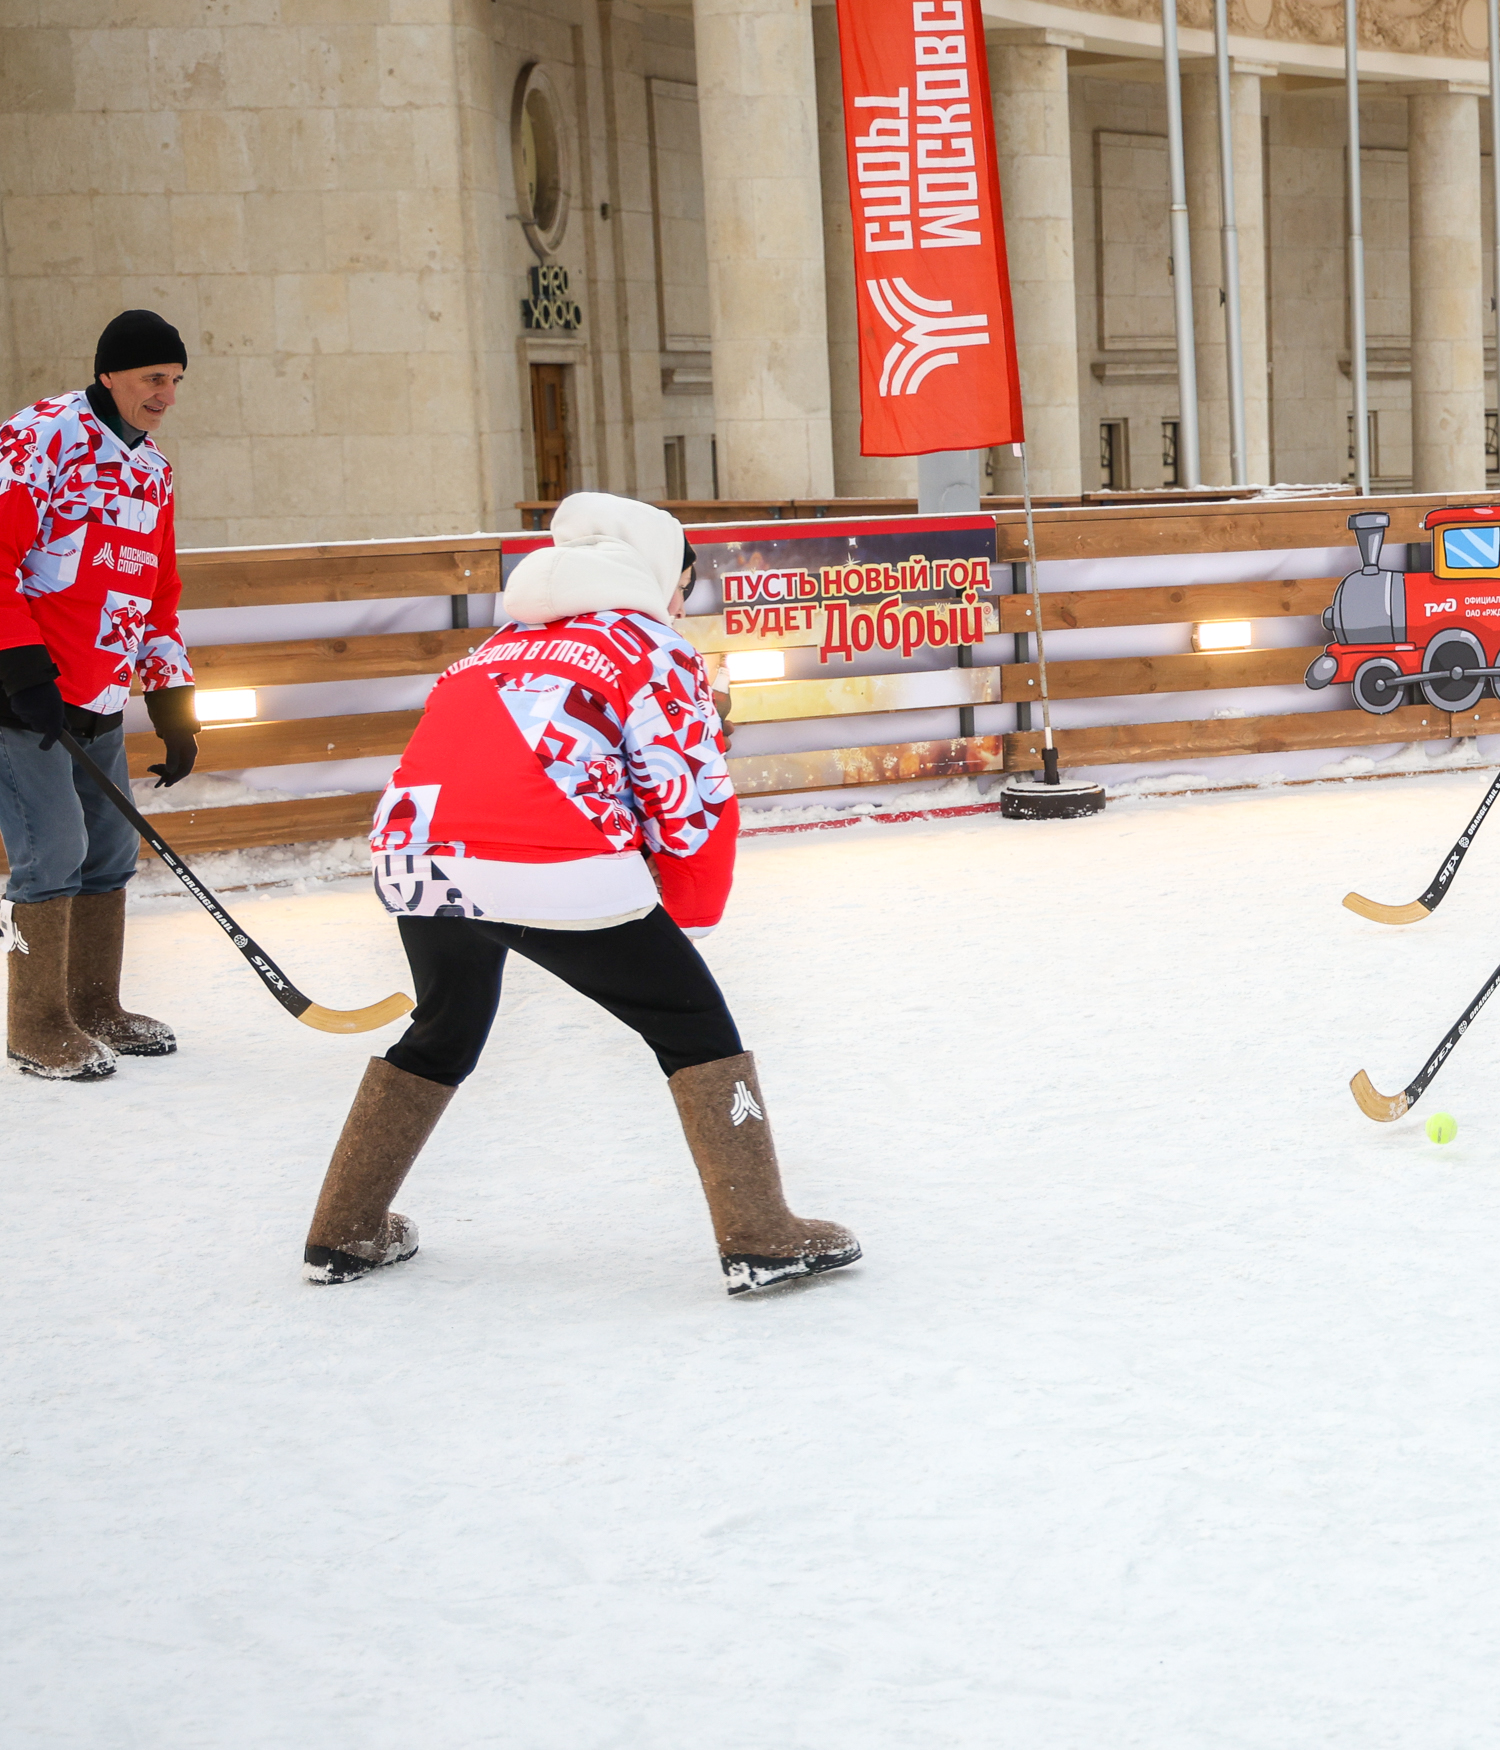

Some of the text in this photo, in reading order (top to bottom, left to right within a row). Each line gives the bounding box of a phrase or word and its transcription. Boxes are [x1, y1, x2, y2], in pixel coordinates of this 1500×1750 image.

[854, 87, 913, 252] СПОРТ
[117, 559, 144, 577] СПОРТ
[724, 558, 991, 601] ПУСТЬ НОВЫЙ ГОД
[725, 592, 985, 664] БУДЕТ Добрый
[1465, 609, 1481, 617] ОАО
[523, 640, 543, 660] В
[540, 639, 622, 689] ГЛАЗАХ
[1467, 789, 1498, 835] ORANGE HAIL
[1438, 851, 1460, 885] STEX
[181, 874, 234, 933] ORANGE HAIL
[251, 955, 288, 991] STEX
[1469, 983, 1495, 1020] ORANGE
[1427, 1038, 1453, 1077] STEX
